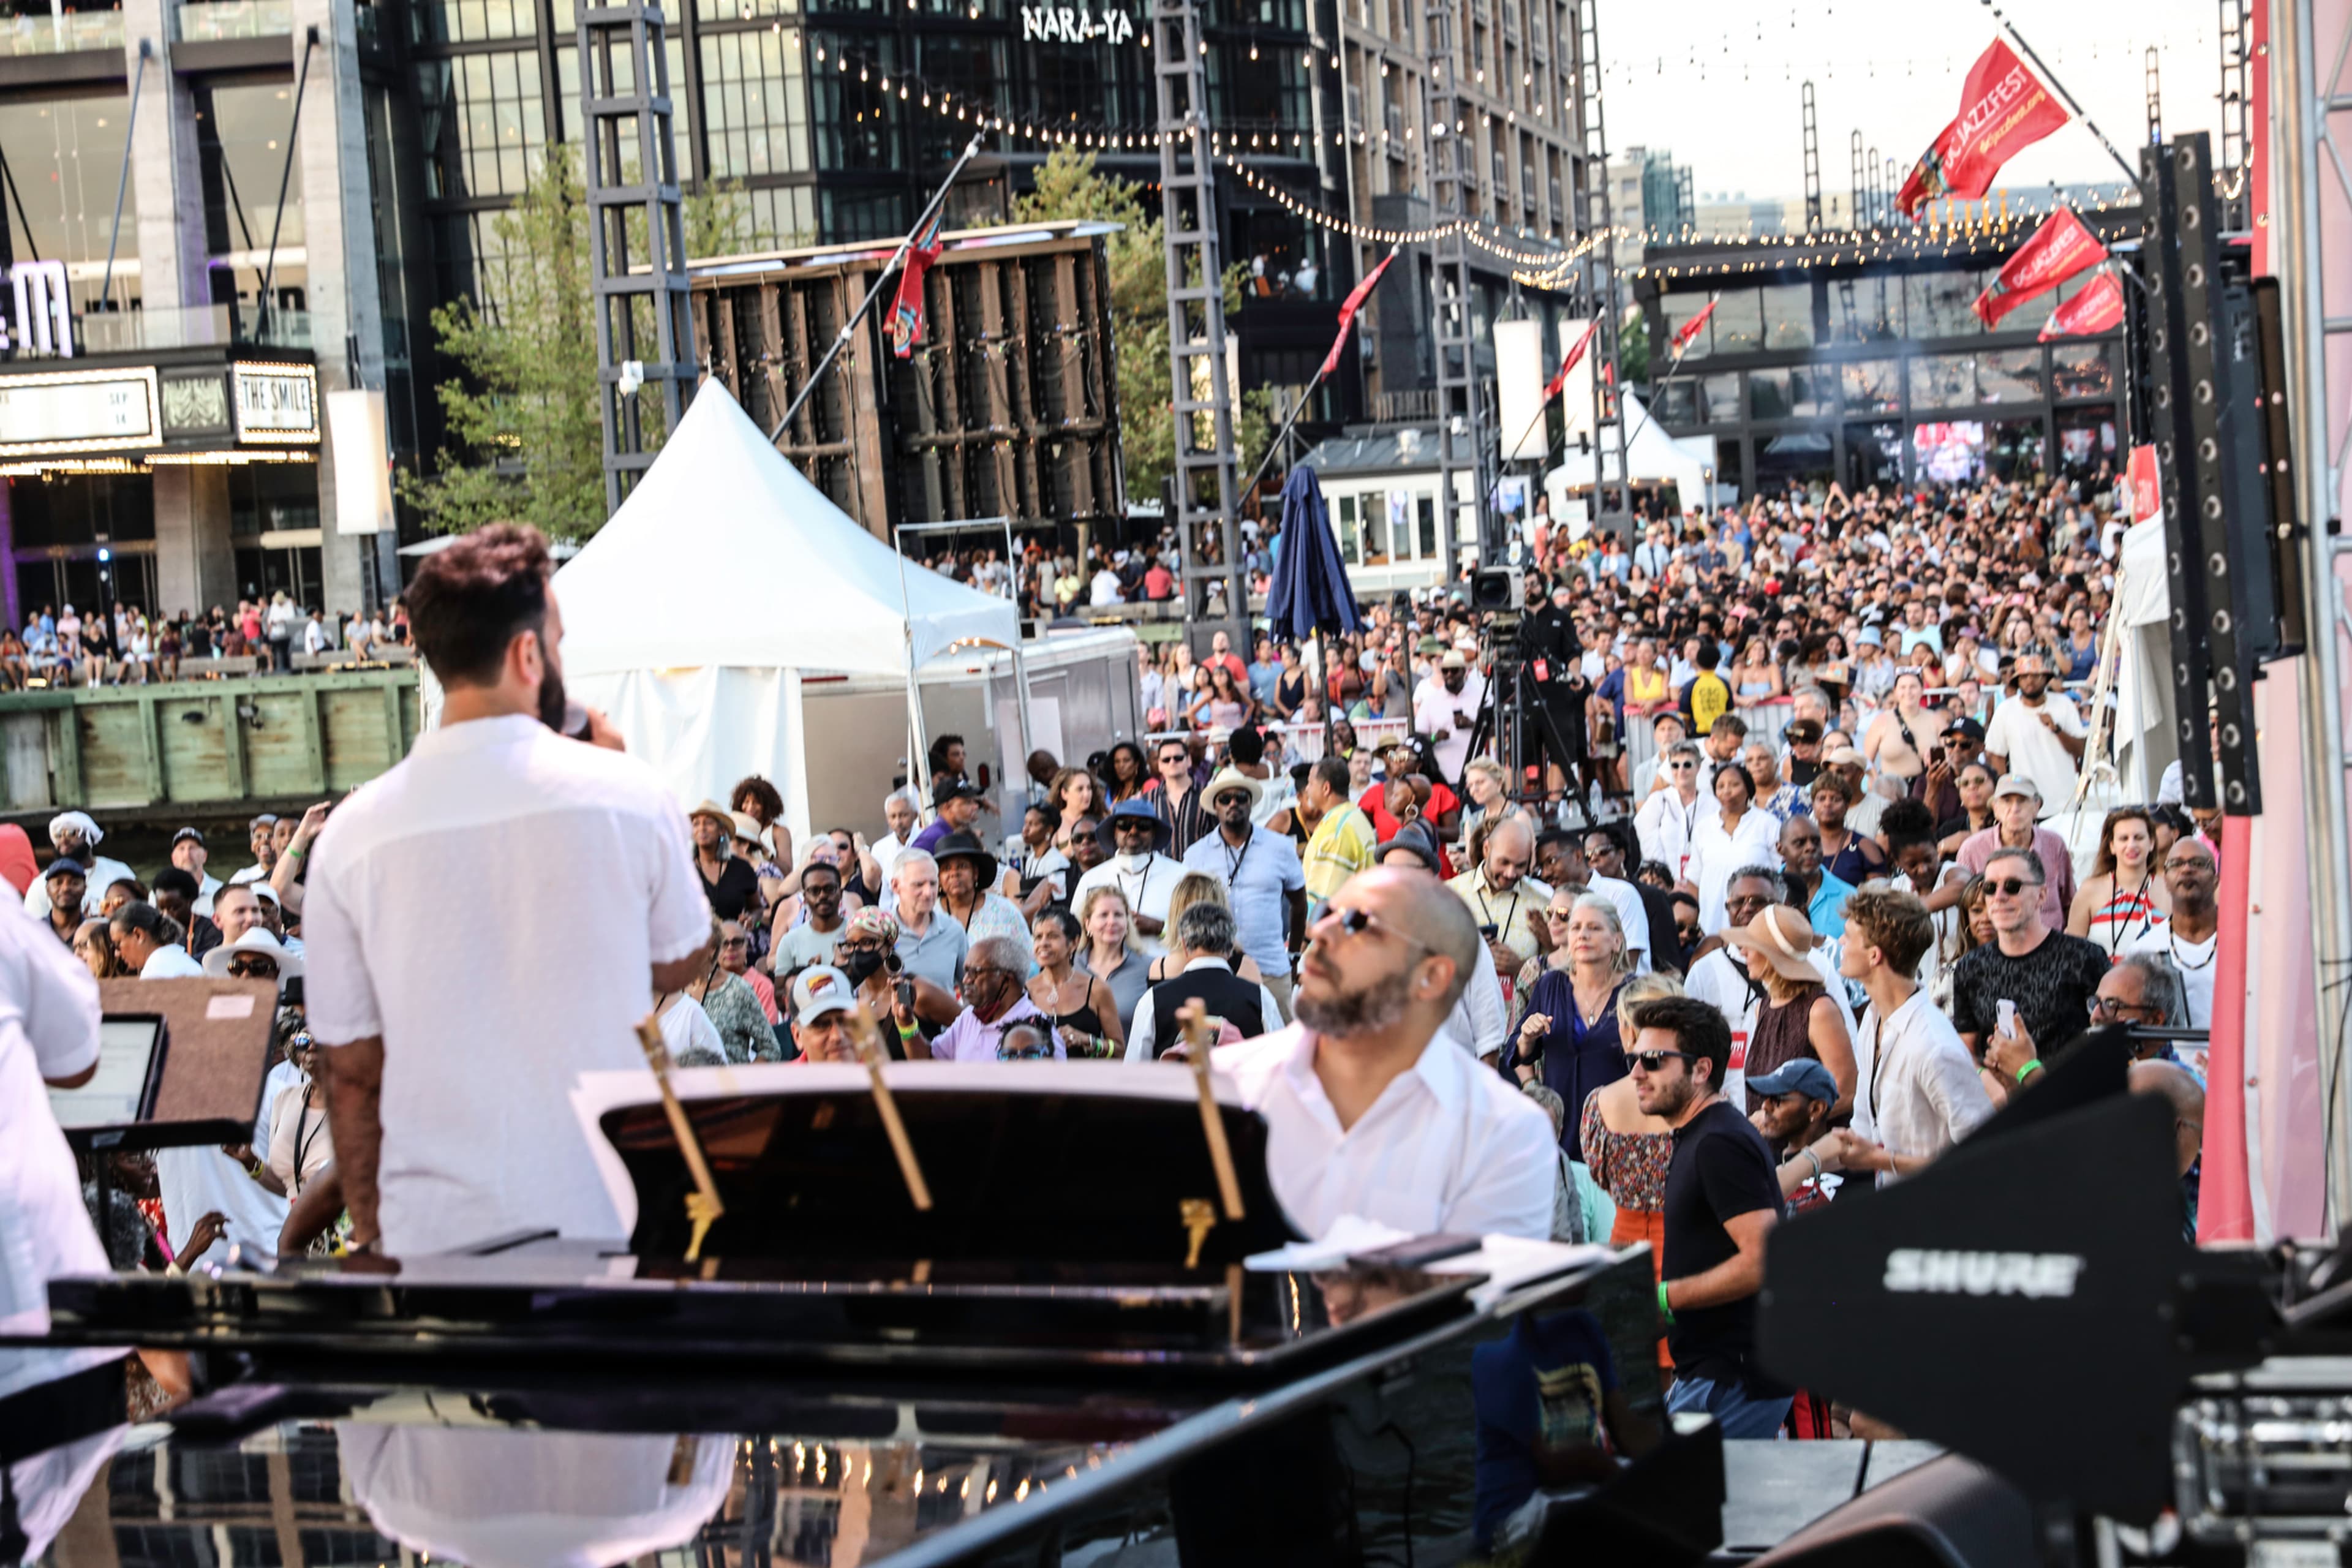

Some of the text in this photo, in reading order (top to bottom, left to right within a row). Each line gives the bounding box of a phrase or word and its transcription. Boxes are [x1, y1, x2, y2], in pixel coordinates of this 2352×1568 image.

[1020, 6, 1133, 45] NARA-YA
[1956, 64, 2027, 147] JAZZFEST
[244, 381, 307, 411] THE SMILE
[1883, 1248, 2080, 1298] SHURE
